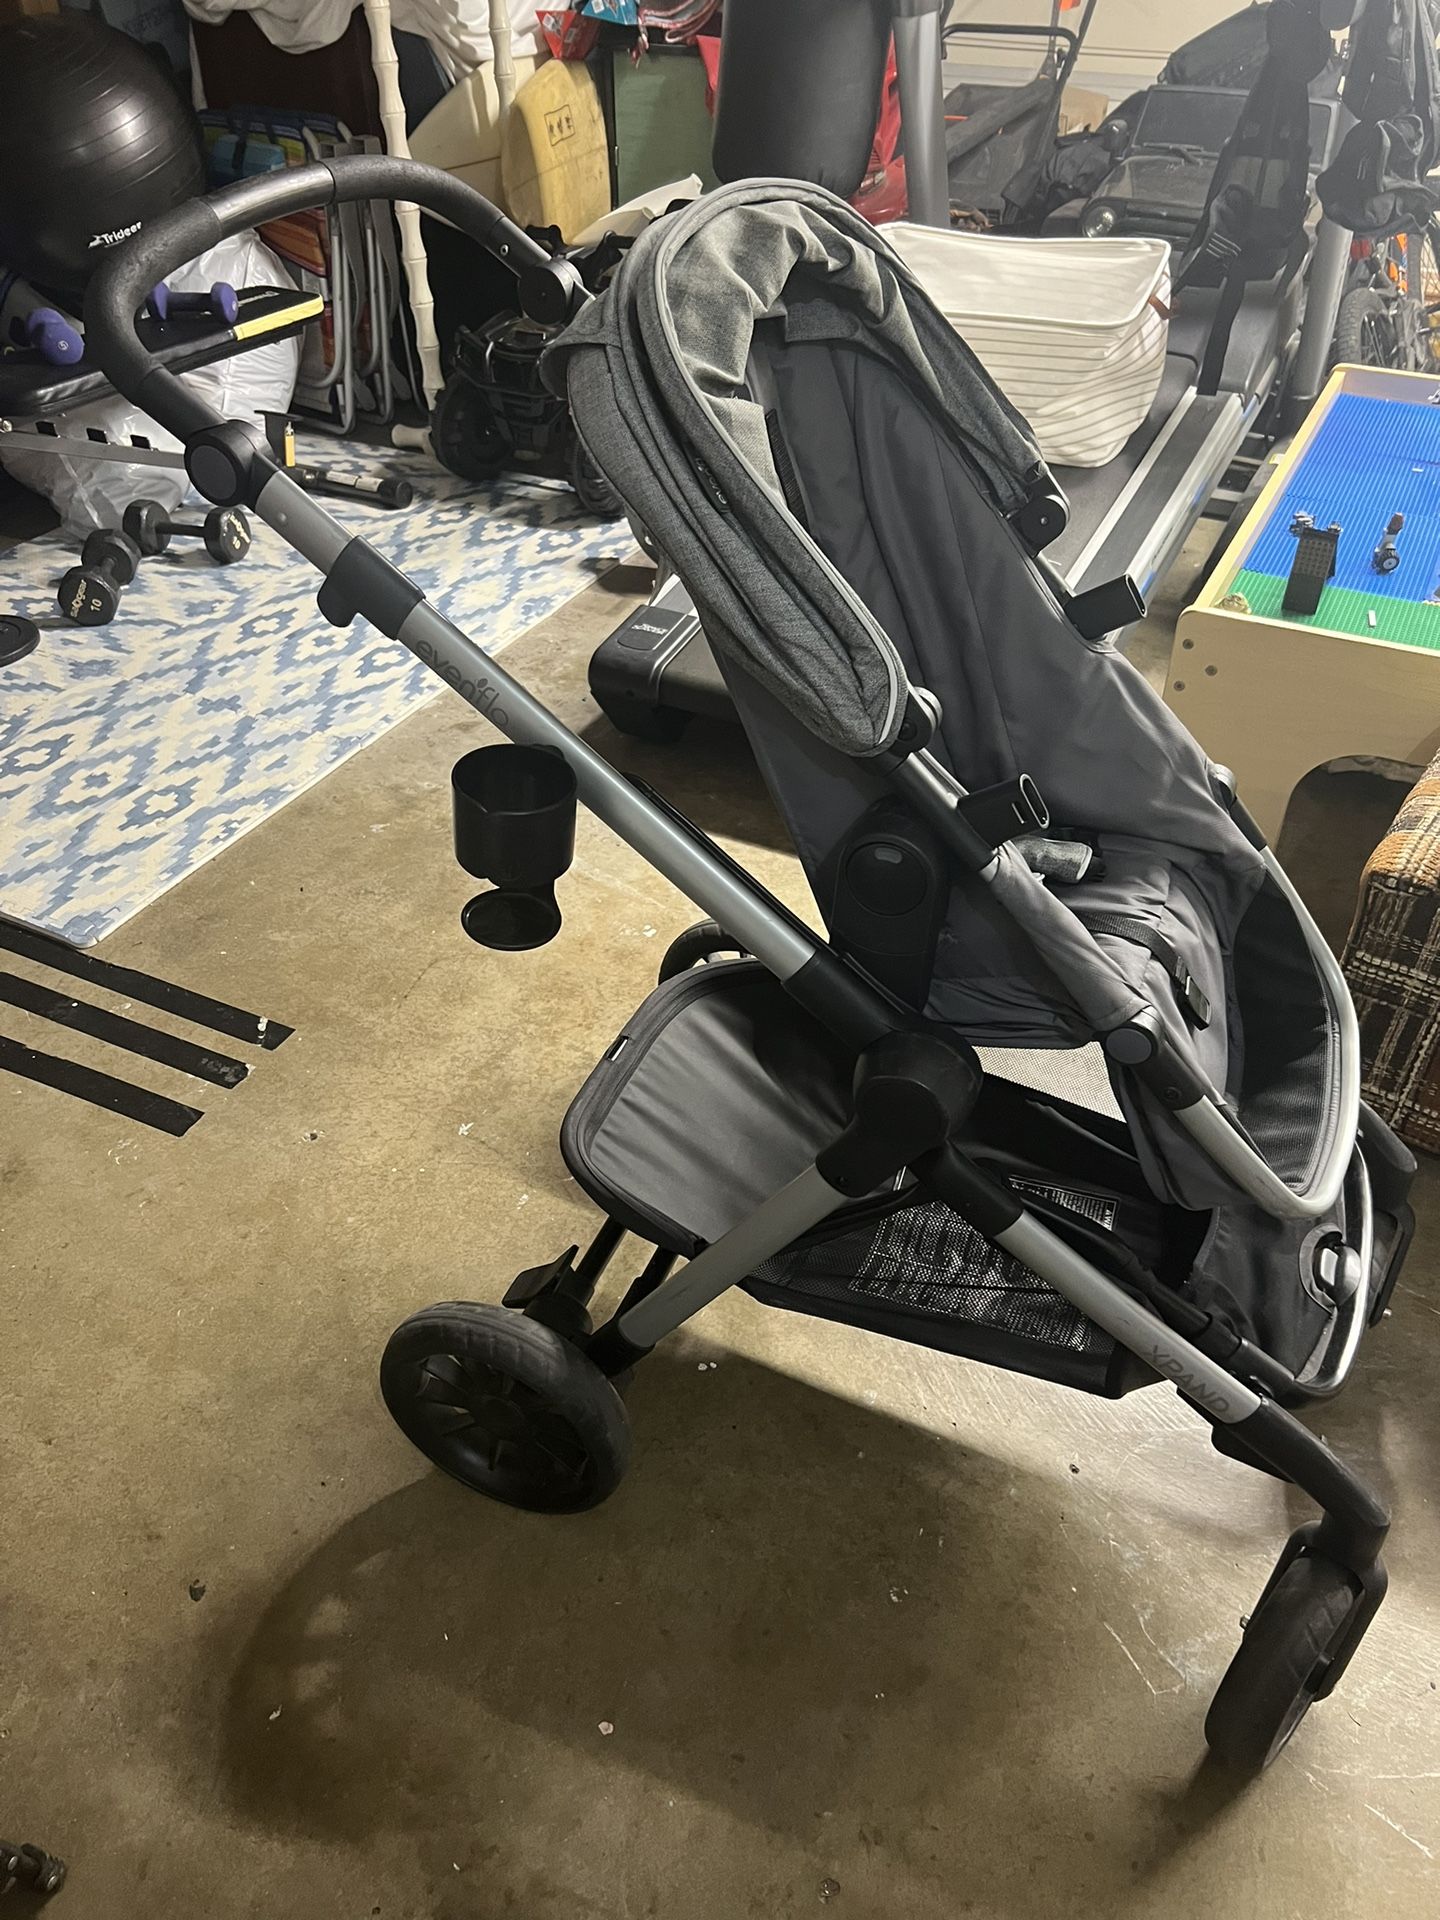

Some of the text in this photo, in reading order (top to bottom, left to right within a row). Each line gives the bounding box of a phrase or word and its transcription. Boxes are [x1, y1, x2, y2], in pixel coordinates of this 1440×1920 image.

[101, 222, 141, 244] Trideer
[90, 598, 102, 611] 10
[415, 640, 509, 727] evenflo
[1141, 1345, 1229, 1412] XPAND
